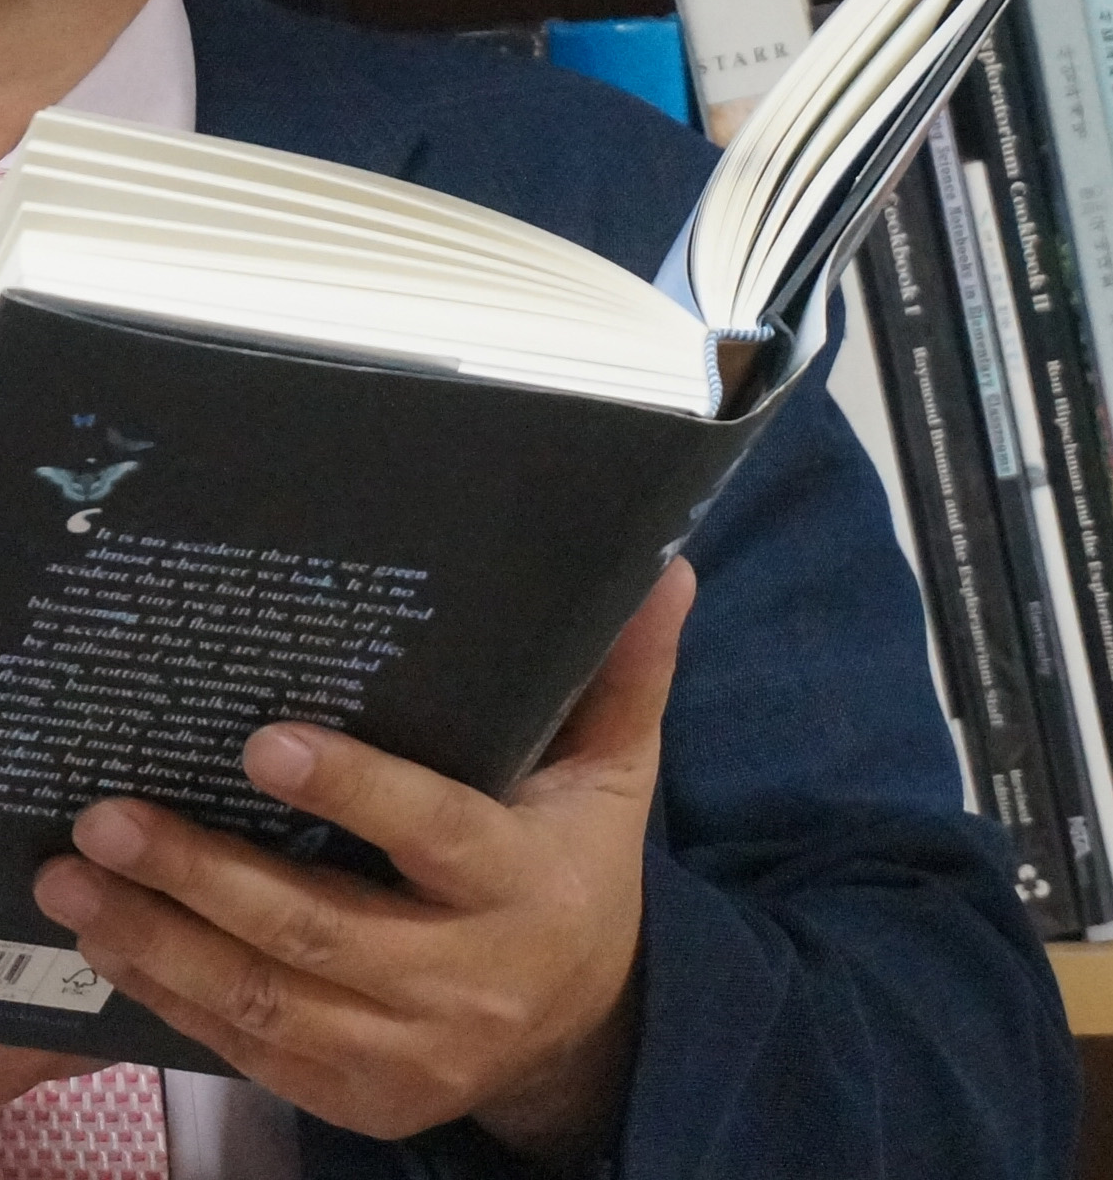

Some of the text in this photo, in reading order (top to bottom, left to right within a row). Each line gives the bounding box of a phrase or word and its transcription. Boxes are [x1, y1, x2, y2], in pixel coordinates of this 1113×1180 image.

[977, 34, 1019, 179] xploratorium
[1009, 181, 1047, 288] Cookbook
[934, 146, 957, 200] Science
[948, 206, 975, 279] Notebooks
[967, 305, 996, 388] Elementary
[912, 346, 942, 425] Raymond
[1047, 360, 1097, 557] Ron Hipschman and the
[945, 499, 963, 531] and
[140, 537, 429, 580] no accident that we green
[951, 534, 970, 562] the
[46, 563, 434, 620] accident that we find ourselves perched
[85, 547, 415, 597] almost wherever we no
[28, 596, 368, 649] blossoming and flourishing tree of
[64, 586, 379, 631] on one tiny twig the midst of
[958, 565, 993, 687] Exploratorium
[22, 634, 48, 648] by
[53, 642, 131, 660] millions
[137, 650, 163, 663] of
[164, 655, 217, 670] other
[32, 620, 380, 671] no accident that we are surrounded
[1, 711, 113, 732] surrounded
[118, 723, 139, 738] by
[147, 729, 214, 745] endless
[43, 735, 82, 746] and
[87, 740, 134, 753] most
[63, 752, 97, 766] but
[102, 759, 133, 770] the
[138, 762, 194, 782] direct
[68, 772, 90, 785] by
[98, 777, 216, 803] non-random
[33, 786, 62, 799] the
